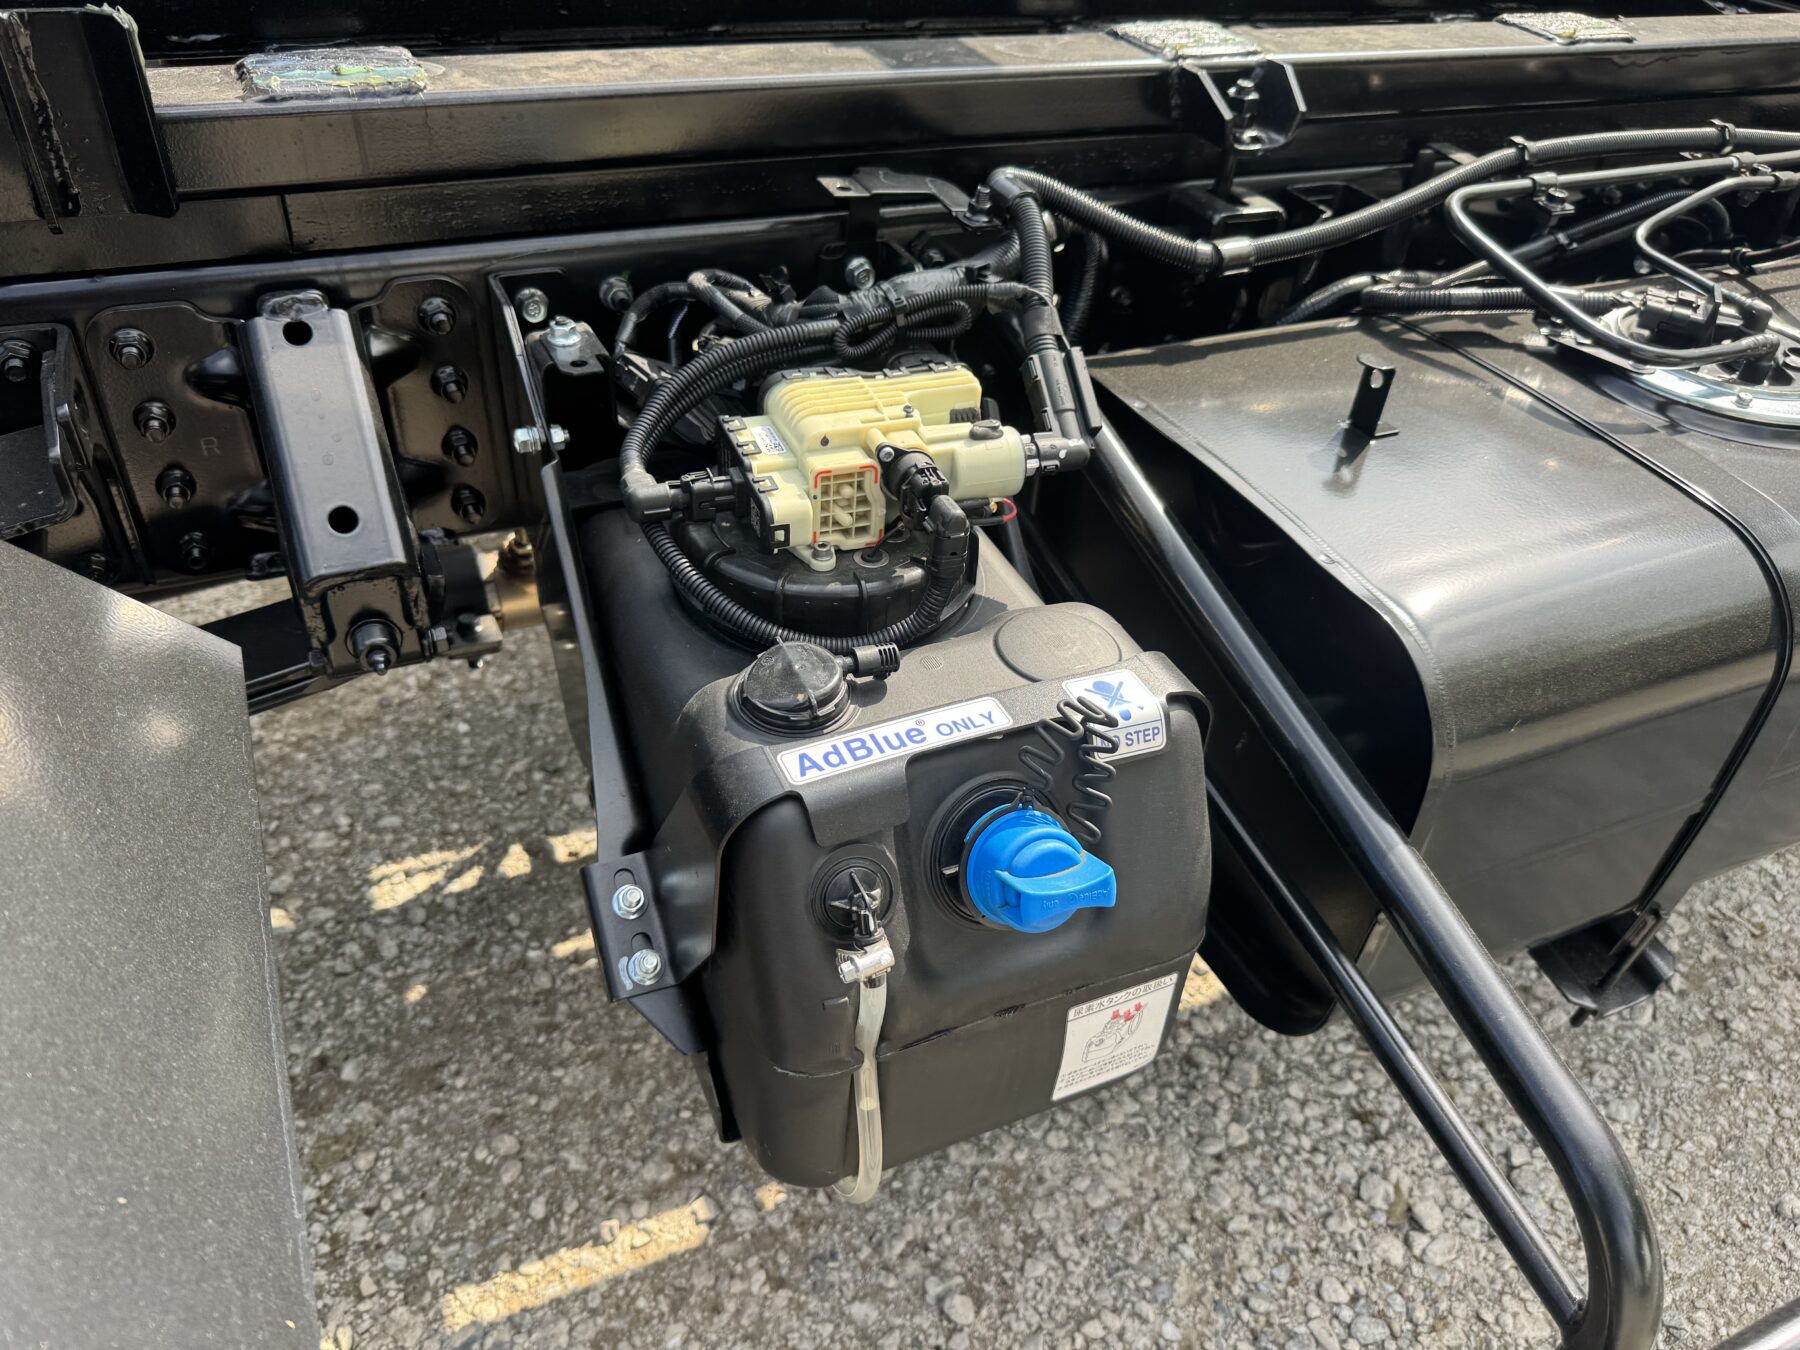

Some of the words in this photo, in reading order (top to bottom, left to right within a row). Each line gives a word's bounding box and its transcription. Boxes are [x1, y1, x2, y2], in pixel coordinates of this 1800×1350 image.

[200, 437, 221, 456] R
[935, 711, 995, 737] ONLY
[1125, 726, 1161, 747] STEP
